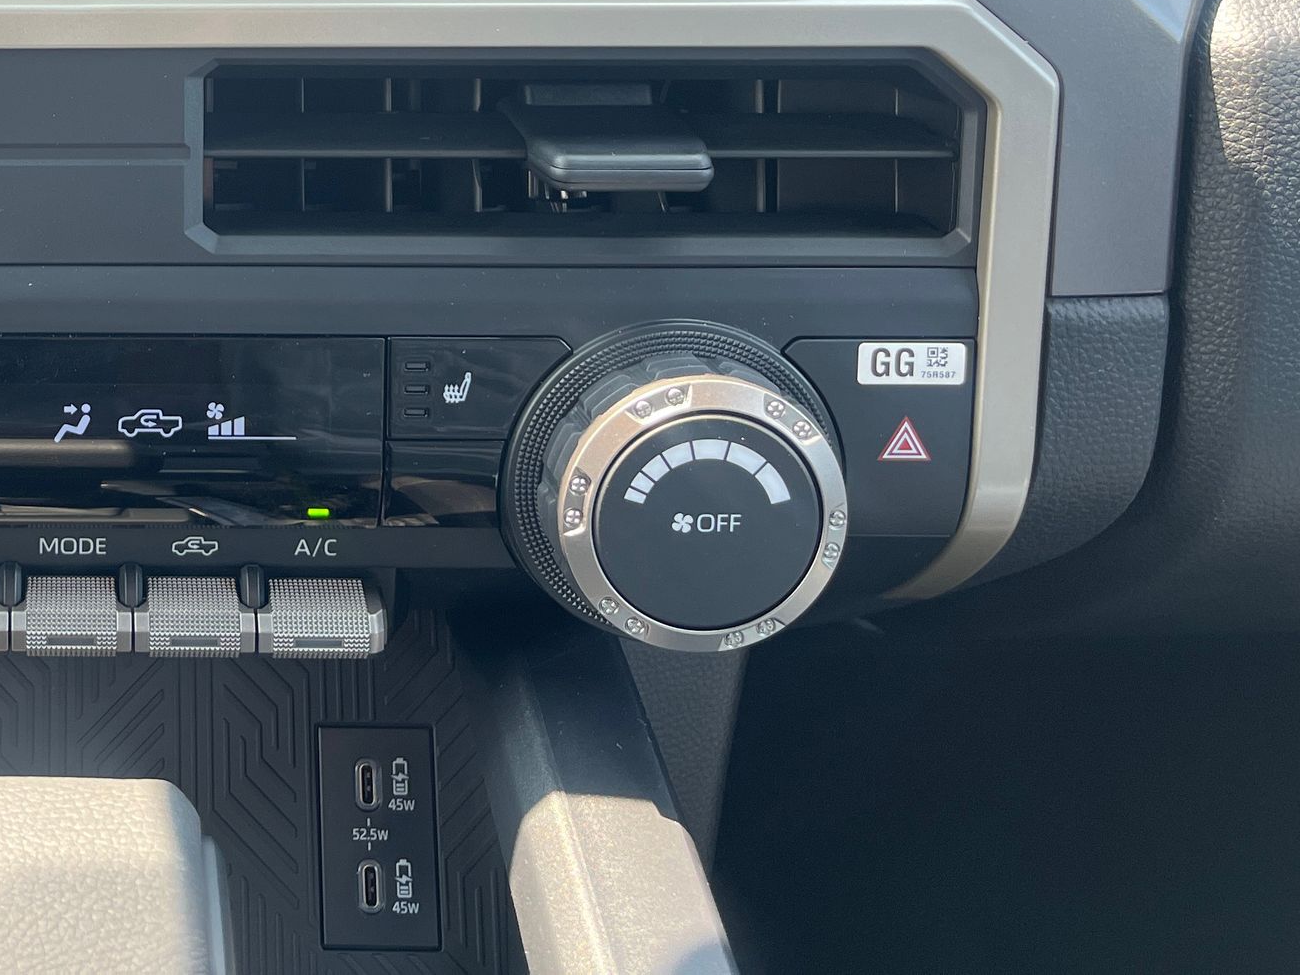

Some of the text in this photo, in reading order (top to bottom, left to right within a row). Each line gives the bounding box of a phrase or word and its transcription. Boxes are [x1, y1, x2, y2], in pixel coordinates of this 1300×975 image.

[870, 347, 915, 377] GG
[695, 513, 742, 534] OFF
[38, 537, 107, 556] MODE
[294, 538, 338, 557] A/C
[388, 798, 416, 812] 45W
[352, 828, 389, 841] 52.5W
[392, 901, 420, 914] 45W
